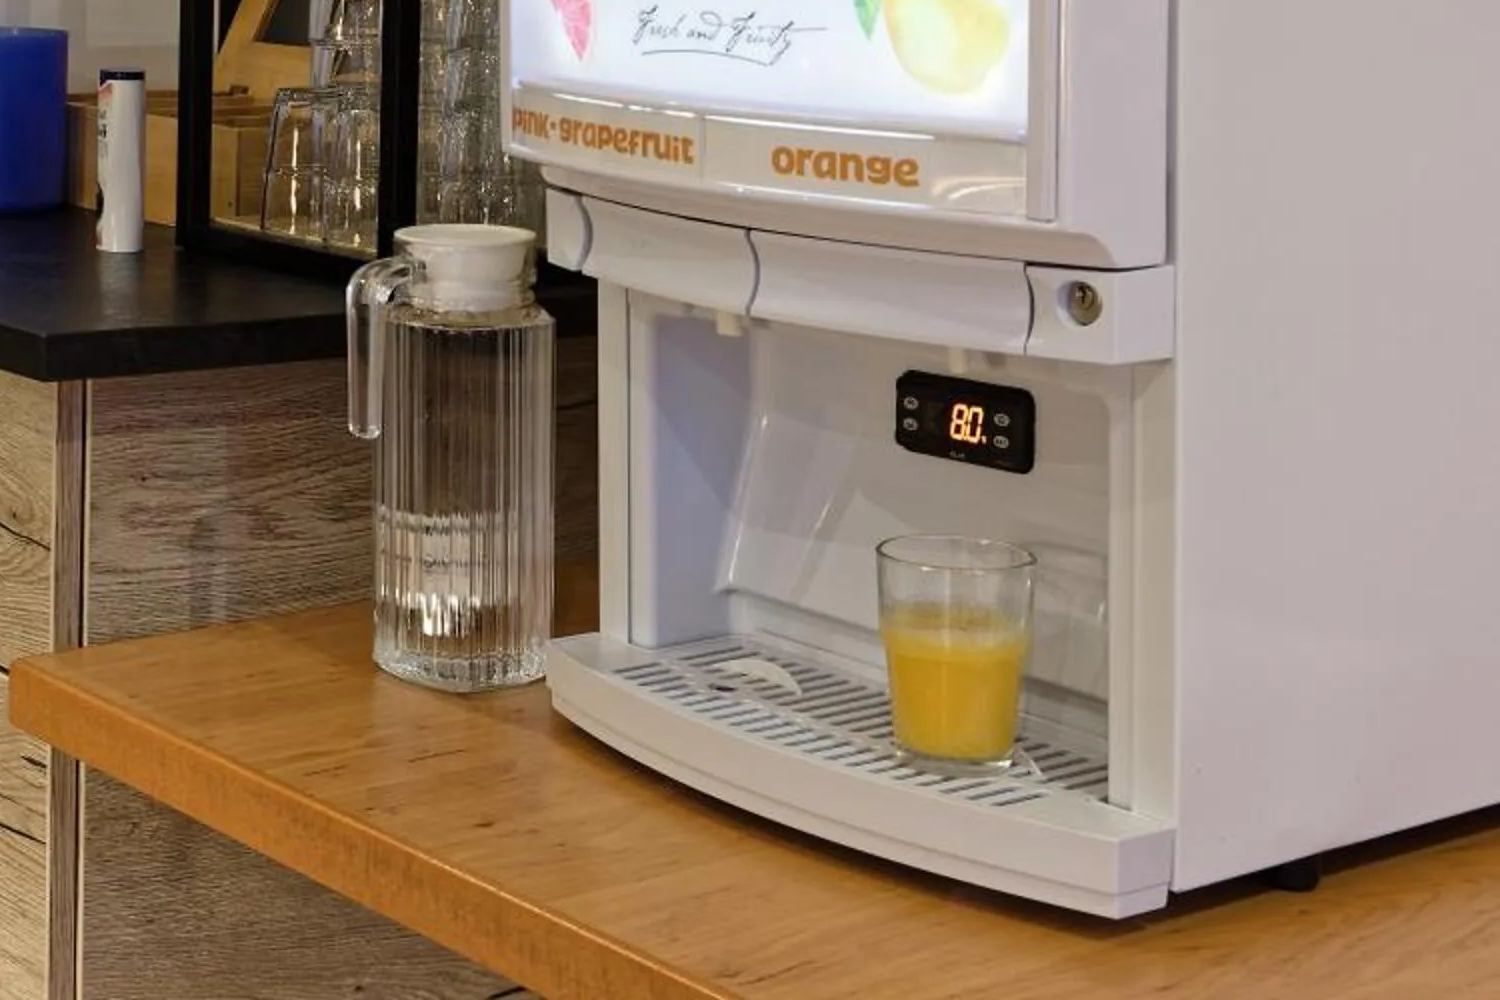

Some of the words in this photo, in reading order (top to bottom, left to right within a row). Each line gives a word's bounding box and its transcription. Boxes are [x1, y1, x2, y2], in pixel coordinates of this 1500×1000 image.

[632, 4, 687, 46] Fresh
[686, 11, 724, 42] and
[771, 146, 920, 188] orange
